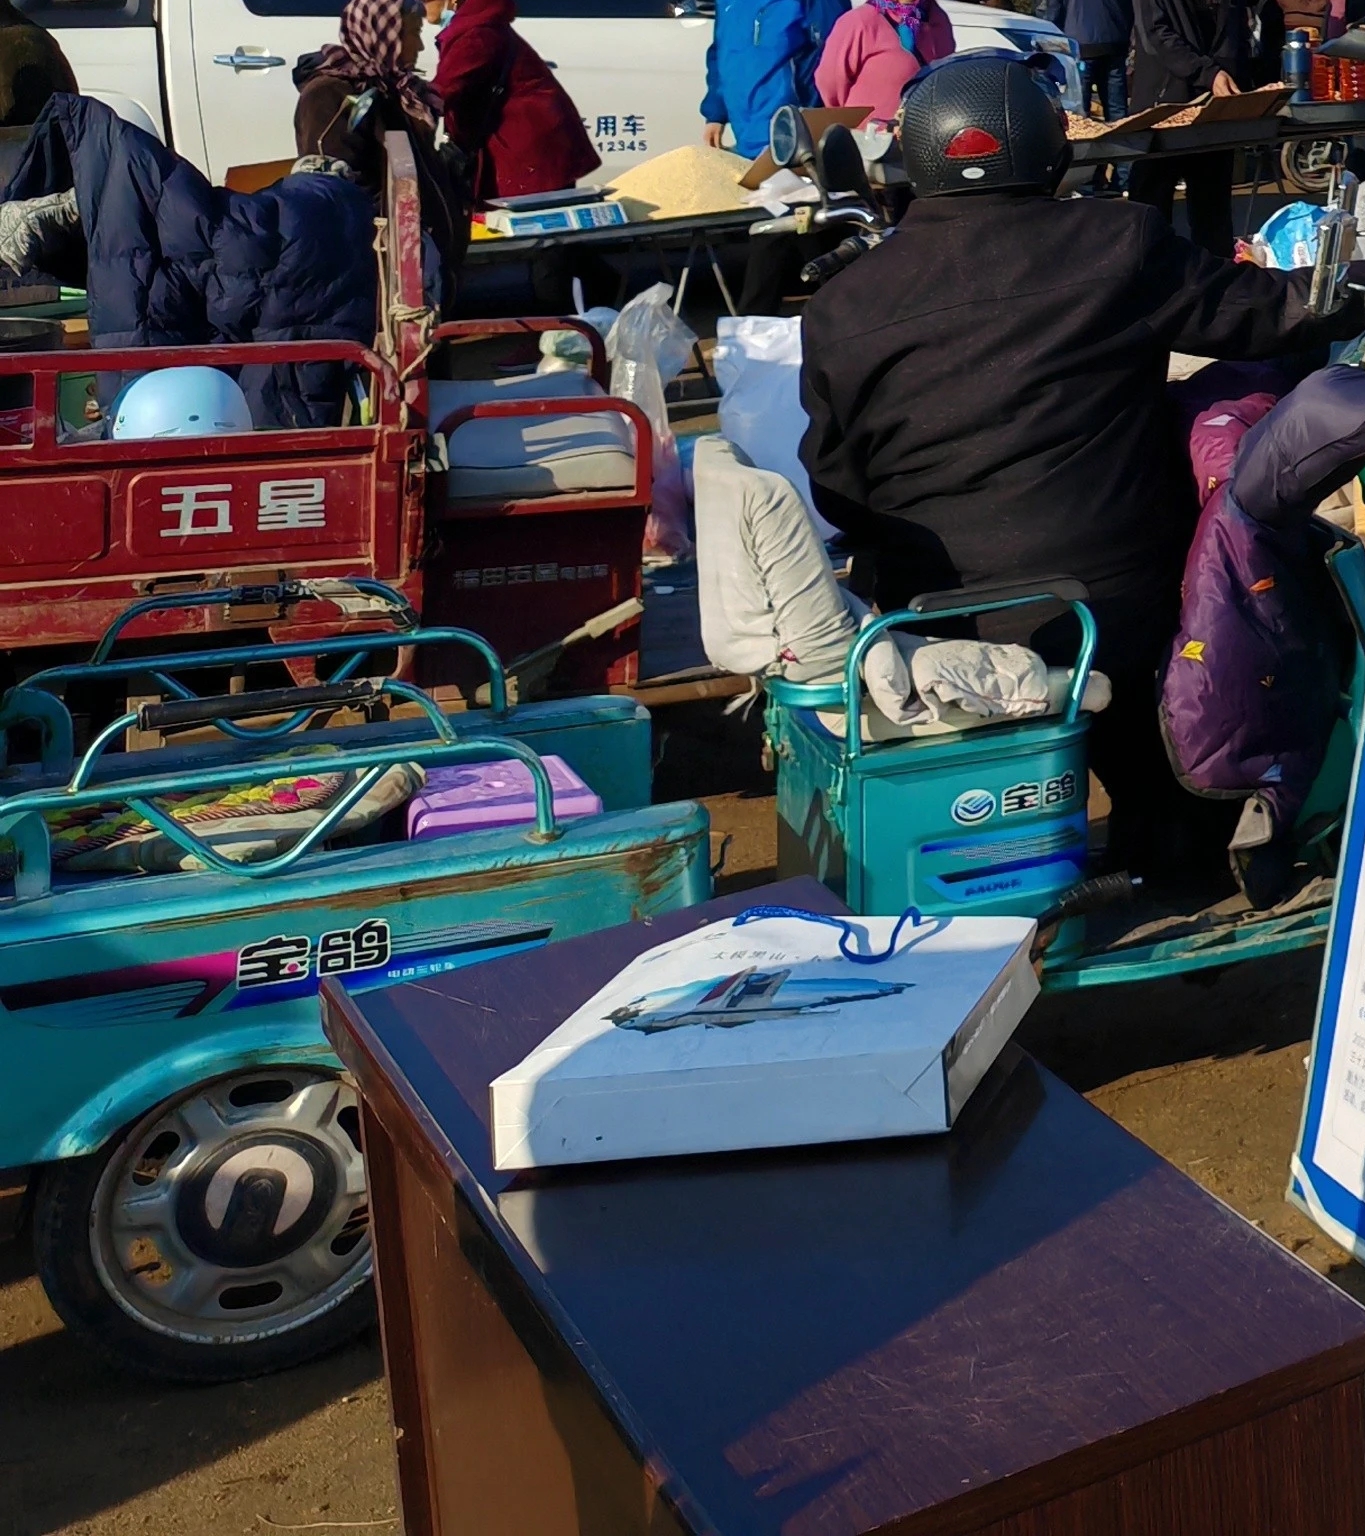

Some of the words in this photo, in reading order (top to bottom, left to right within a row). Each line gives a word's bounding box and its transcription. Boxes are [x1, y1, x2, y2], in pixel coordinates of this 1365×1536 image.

[581, 115, 646, 137] 用车
[160, 474, 326, 537] 五星
[1001, 769, 1076, 816] 宝鸽
[237, 918, 392, 990] 宝鸽
